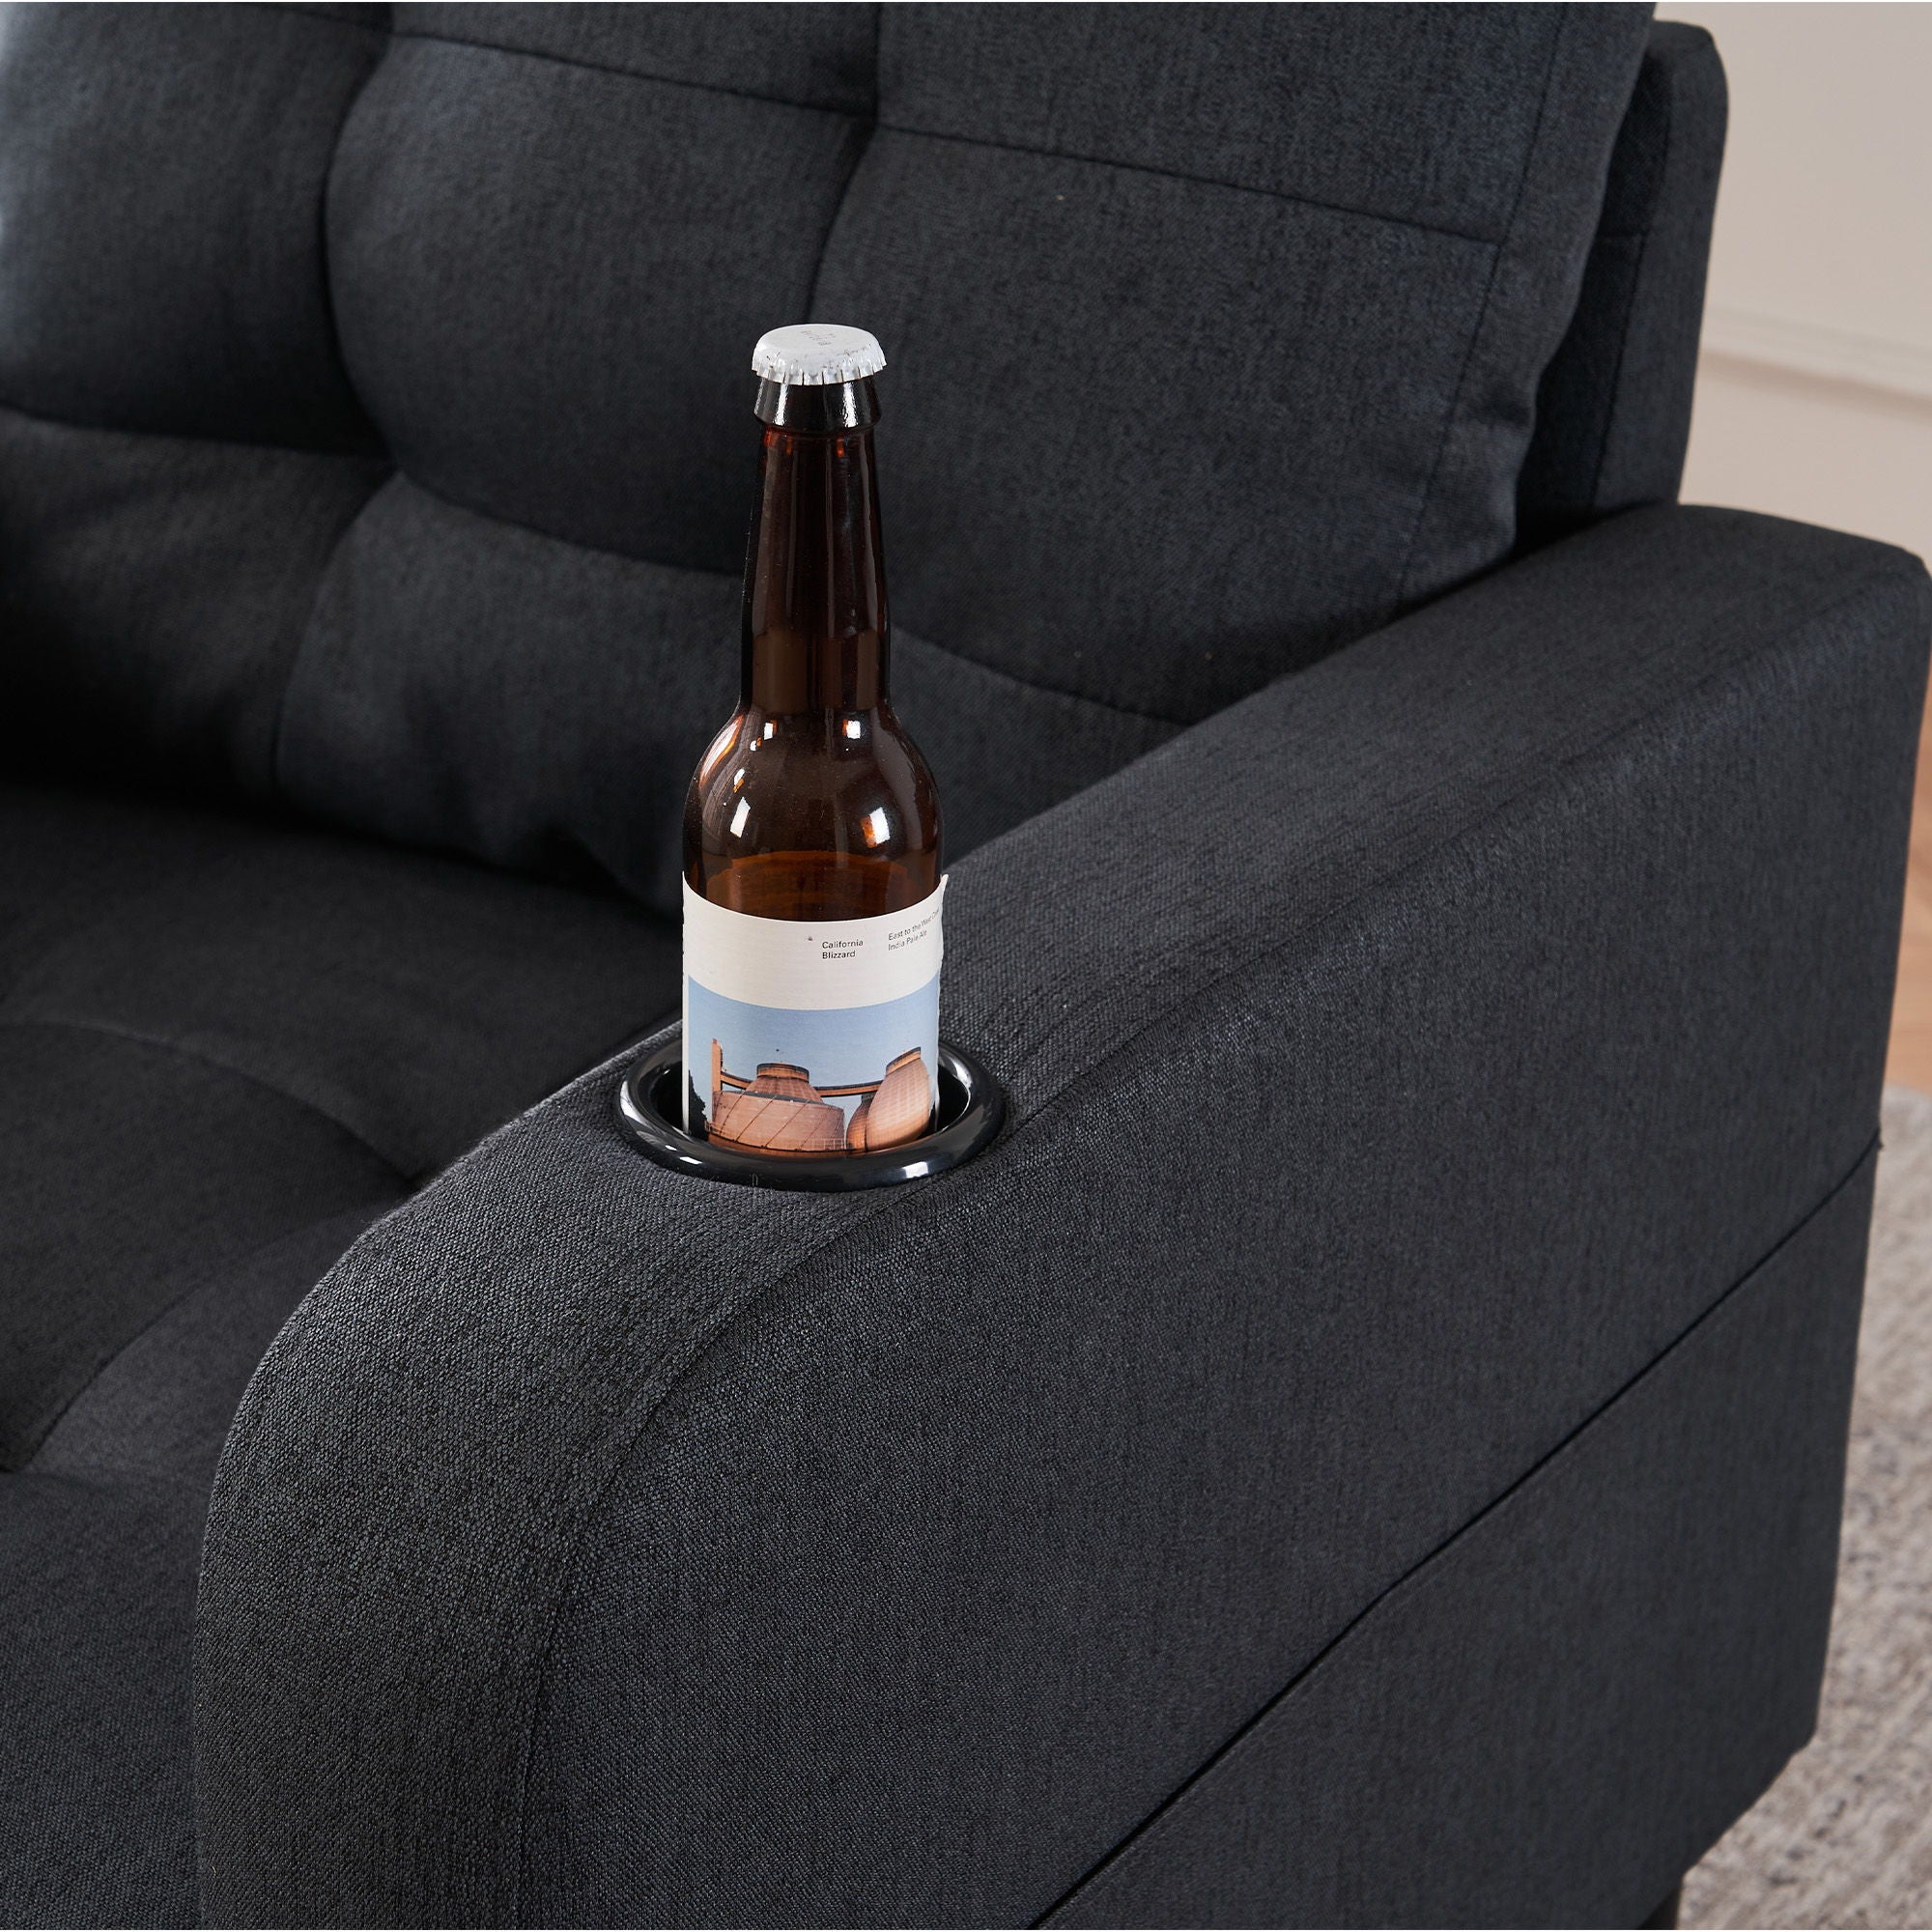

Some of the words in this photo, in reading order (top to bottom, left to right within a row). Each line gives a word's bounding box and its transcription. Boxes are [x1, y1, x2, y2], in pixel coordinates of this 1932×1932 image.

[888, 930, 903, 941] East
[912, 923, 922, 933] the
[821, 938, 864, 950] California
[888, 940, 905, 952] India
[906, 934, 919, 946] Pale
[822, 950, 856, 959] Blizzard
